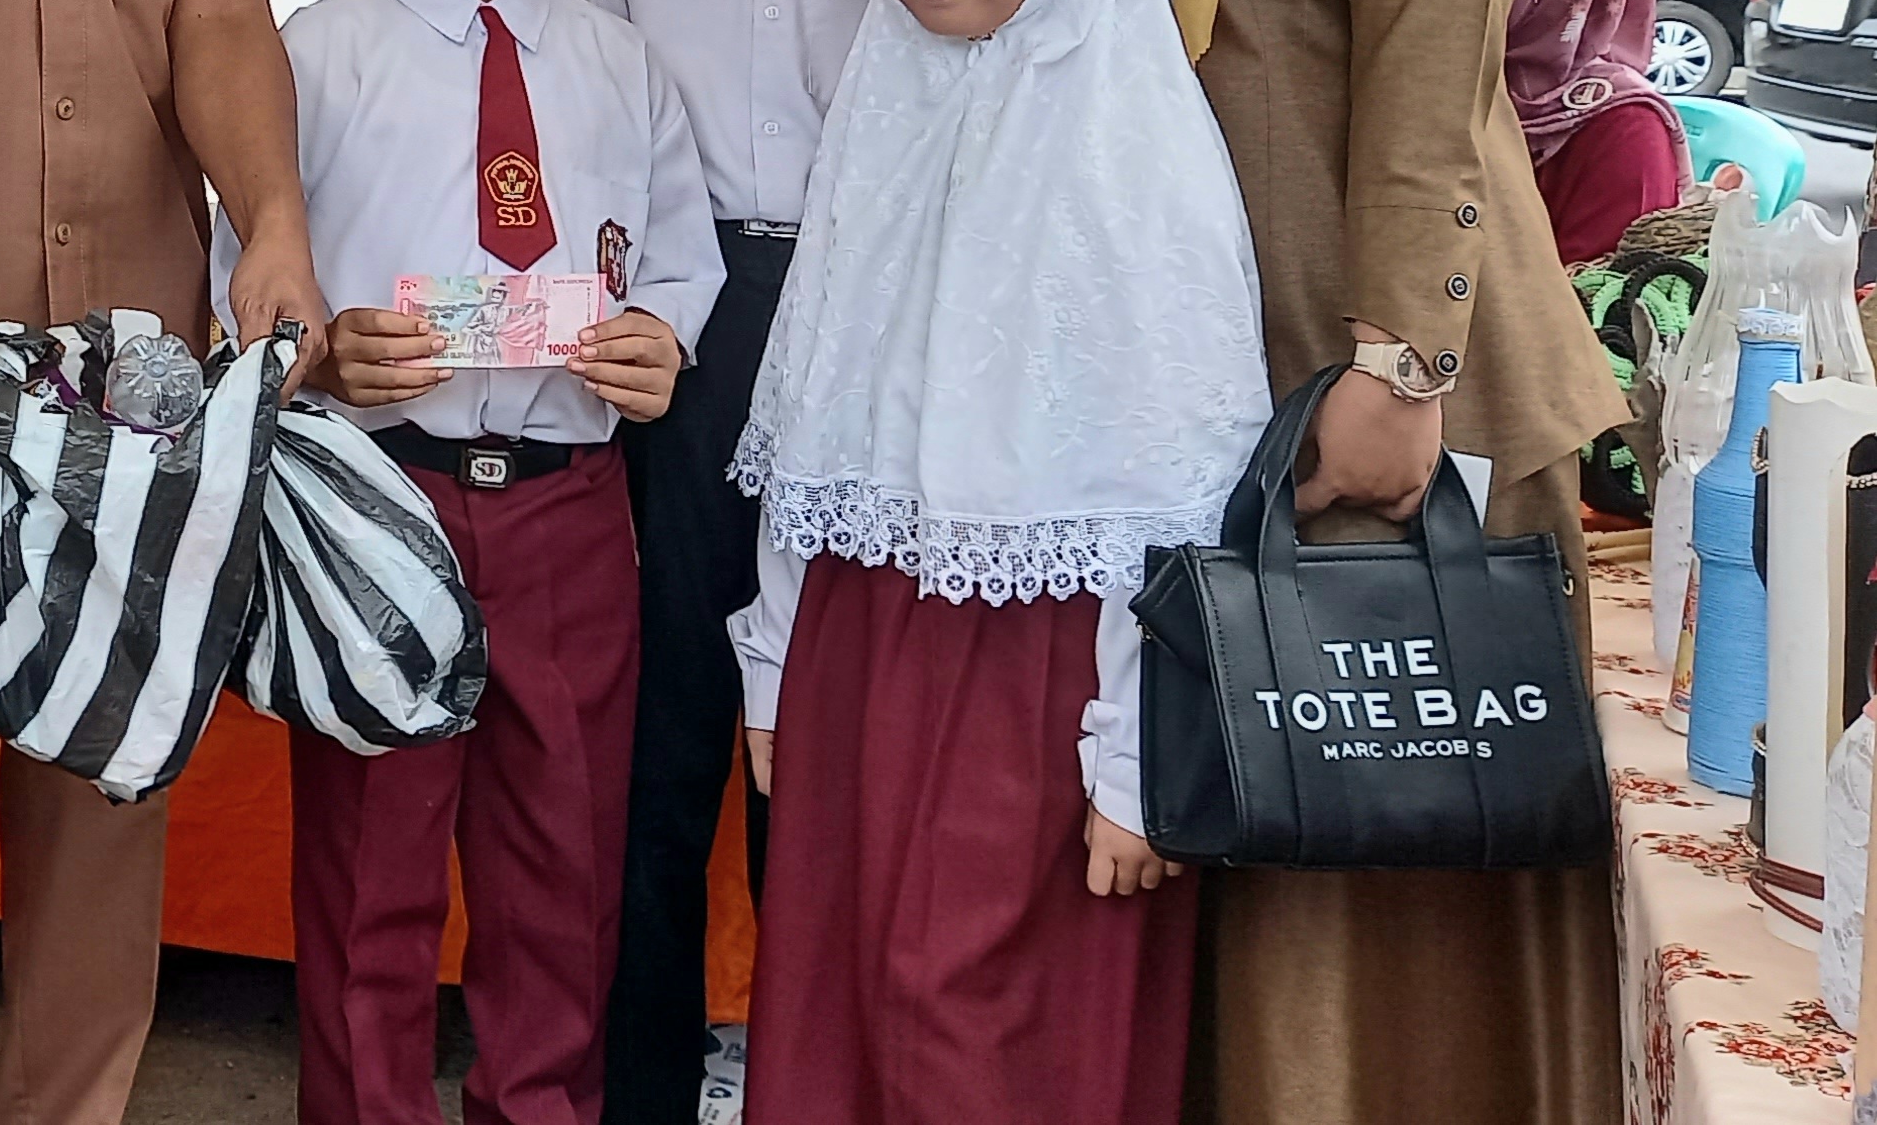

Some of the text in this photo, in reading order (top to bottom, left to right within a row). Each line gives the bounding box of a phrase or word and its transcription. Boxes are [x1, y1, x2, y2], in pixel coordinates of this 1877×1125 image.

[496, 206, 537, 226] SD
[1322, 638, 1440, 679] THE
[1255, 682, 1549, 732] TOTE BAG
[1322, 741, 1384, 761] MARC
